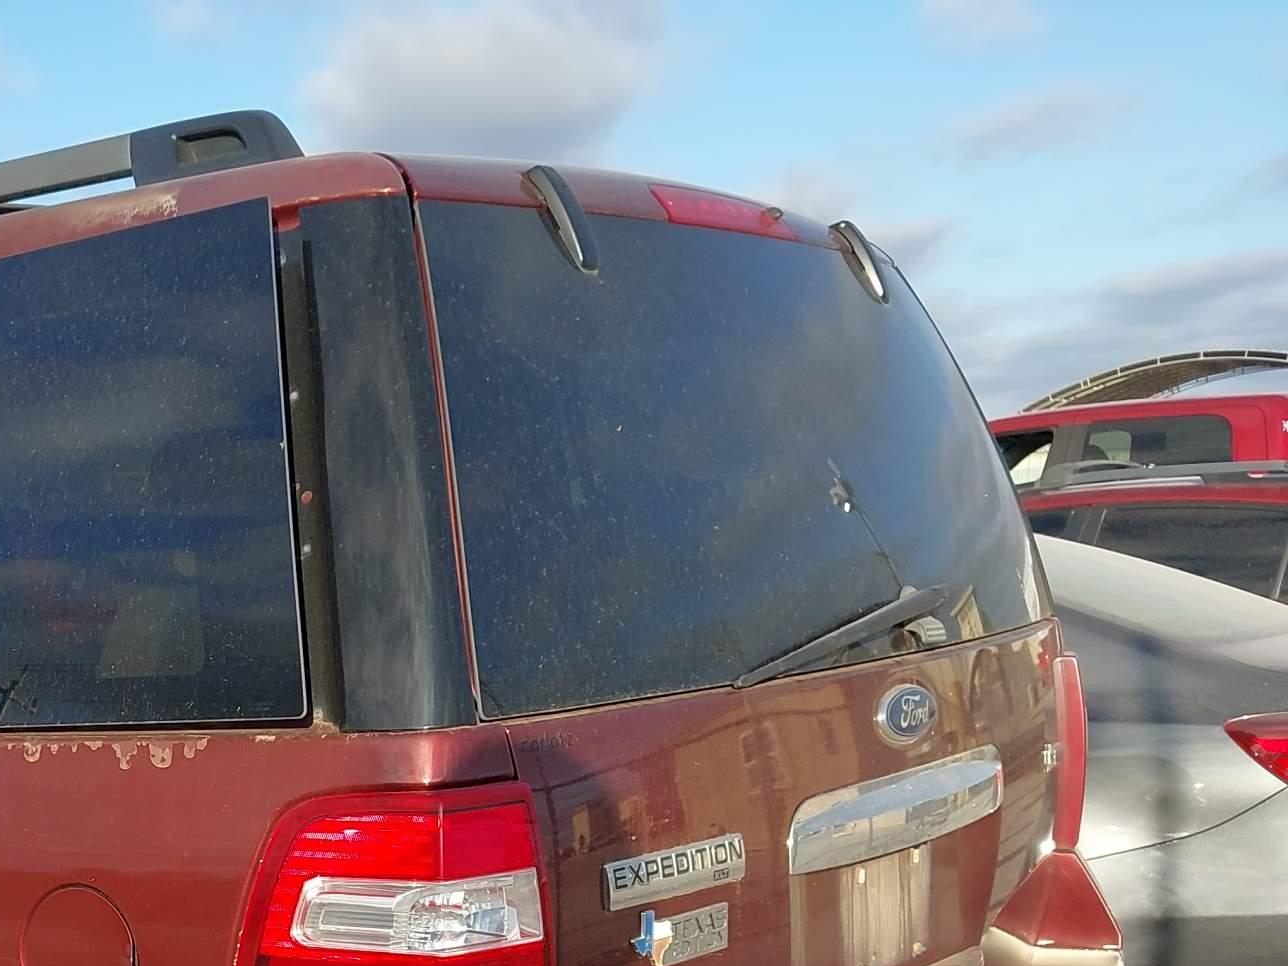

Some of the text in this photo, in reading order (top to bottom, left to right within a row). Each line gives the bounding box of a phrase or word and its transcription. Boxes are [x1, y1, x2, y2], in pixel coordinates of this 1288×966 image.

[900, 694, 929, 728] Ford
[613, 838, 743, 890] EXPEDITION
[672, 909, 727, 939] TEXAS
